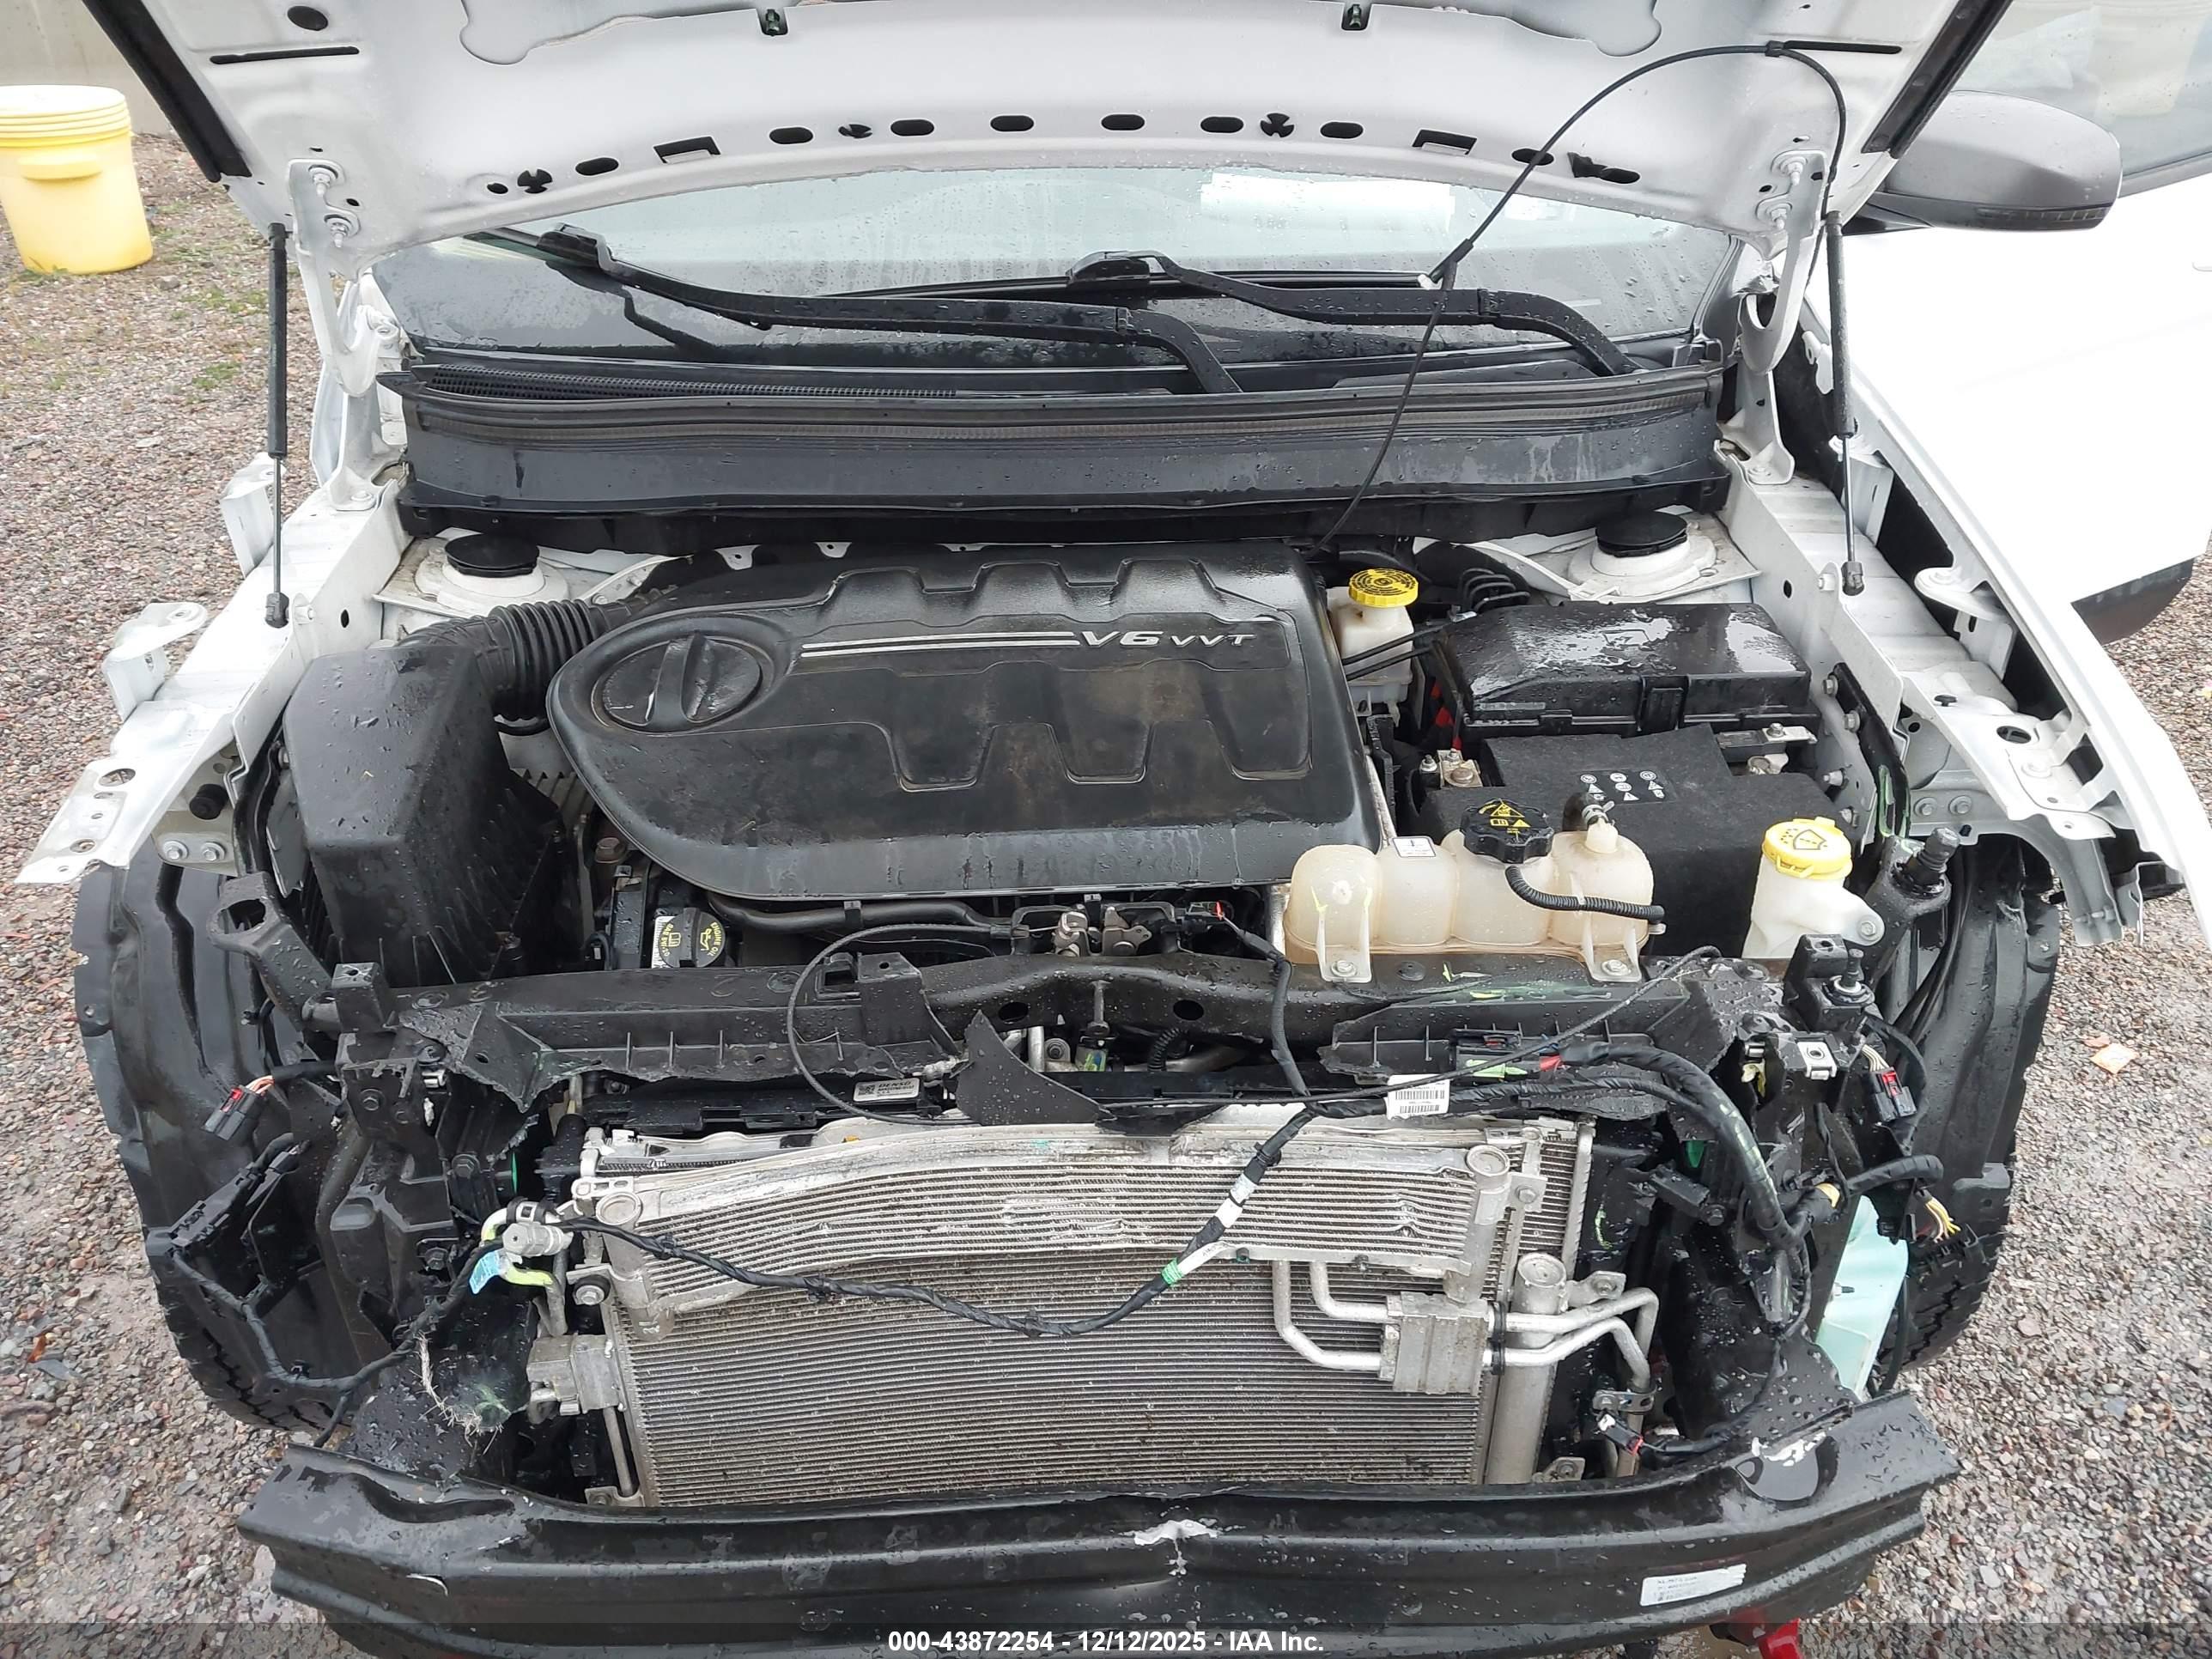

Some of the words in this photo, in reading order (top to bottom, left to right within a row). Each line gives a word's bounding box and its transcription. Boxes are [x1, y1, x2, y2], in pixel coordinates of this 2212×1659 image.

[1081, 630, 1164, 647] V6
[1170, 634, 1256, 647] VVT
[662, 923, 674, 936] SAE
[710, 921, 722, 945] ENGINE
[707, 946, 719, 957] OIL
